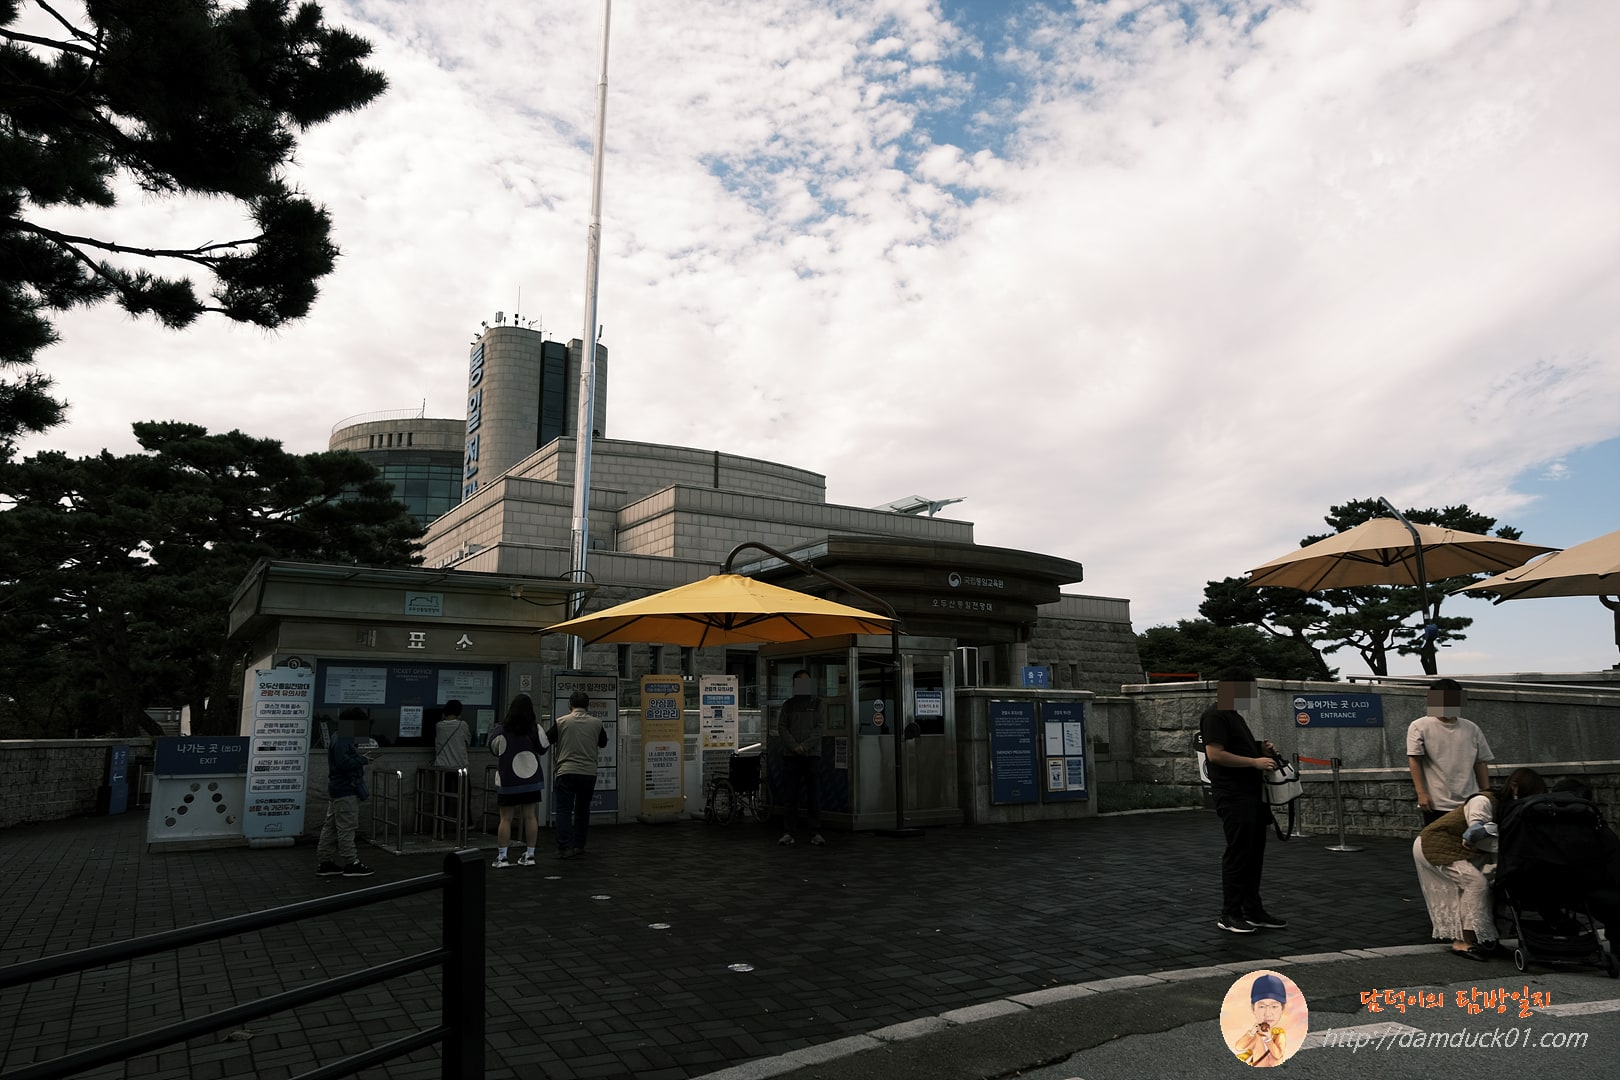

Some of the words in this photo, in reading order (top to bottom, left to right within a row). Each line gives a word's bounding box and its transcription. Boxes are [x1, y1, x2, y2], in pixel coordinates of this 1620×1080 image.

[963, 576, 1004, 589] 국립통일교육원
[931, 599, 993, 611] 오두산통일전망대
[259, 682, 310, 691] 오두산통일전망대
[1307, 700, 1338, 709] 들어가는
[1341, 700, 1349, 709] 곳
[177, 744, 206, 753] 나가는
[209, 743, 218, 753] 곳
